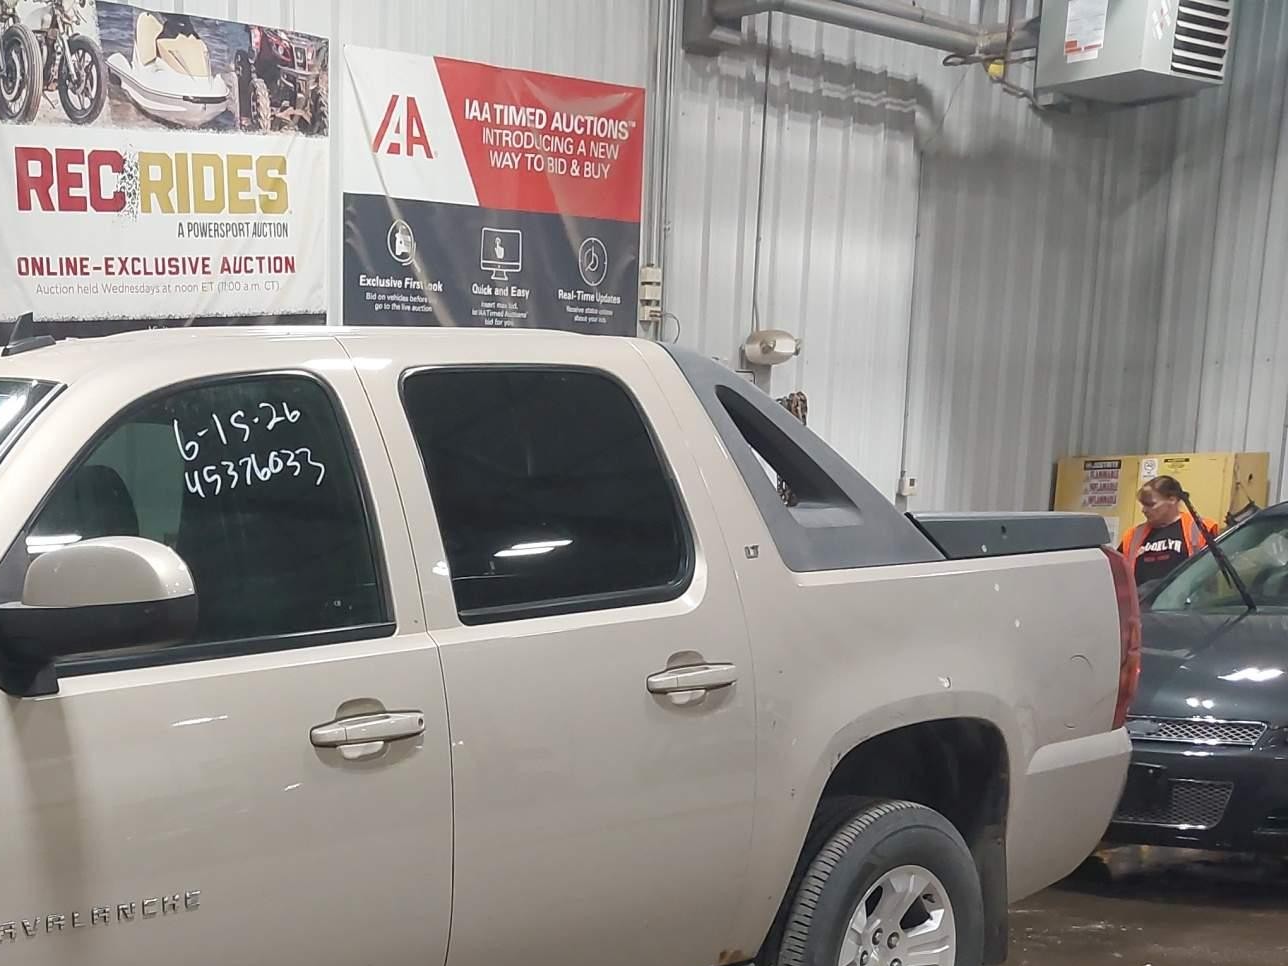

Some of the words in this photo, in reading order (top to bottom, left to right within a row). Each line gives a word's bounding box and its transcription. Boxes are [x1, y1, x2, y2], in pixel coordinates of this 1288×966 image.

[464, 98, 491, 122] IAA
[493, 104, 547, 131] TIMED
[482, 127, 574, 155] INTRODUCING
[577, 139, 587, 156] A
[589, 141, 620, 160] NEW
[489, 151, 522, 171] WAY
[525, 153, 544, 172] TO
[547, 157, 567, 175] BID
[570, 160, 581, 176] &
[584, 161, 611, 179] BUY
[14, 146, 129, 213] REC
[138, 151, 290, 215] RIDES
[177, 222, 186, 238] A
[187, 221, 250, 239] POWERSPORT
[251, 221, 289, 239] AUCTION
[17, 255, 212, 277] ONLINE-EXCLUSIVE
[220, 255, 297, 274] AUCTION
[36, 283, 75, 295] Auction
[77, 283, 99, 294] held
[101, 282, 160, 296] Wednesdays
[162, 283, 171, 294] at
[175, 284, 199, 293] noon
[201, 281, 214, 292] ET
[359, 274, 402, 289] Exclusive
[365, 292, 377, 300] Bid
[472, 284, 492, 296] Quick
[494, 286, 509, 297] and
[511, 287, 530, 300] Easy
[557, 289, 595, 302] Real-Time
[595, 291, 622, 305] Updates
[184, 447, 326, 498] 45376033
[744, 544, 759, 560] LT
